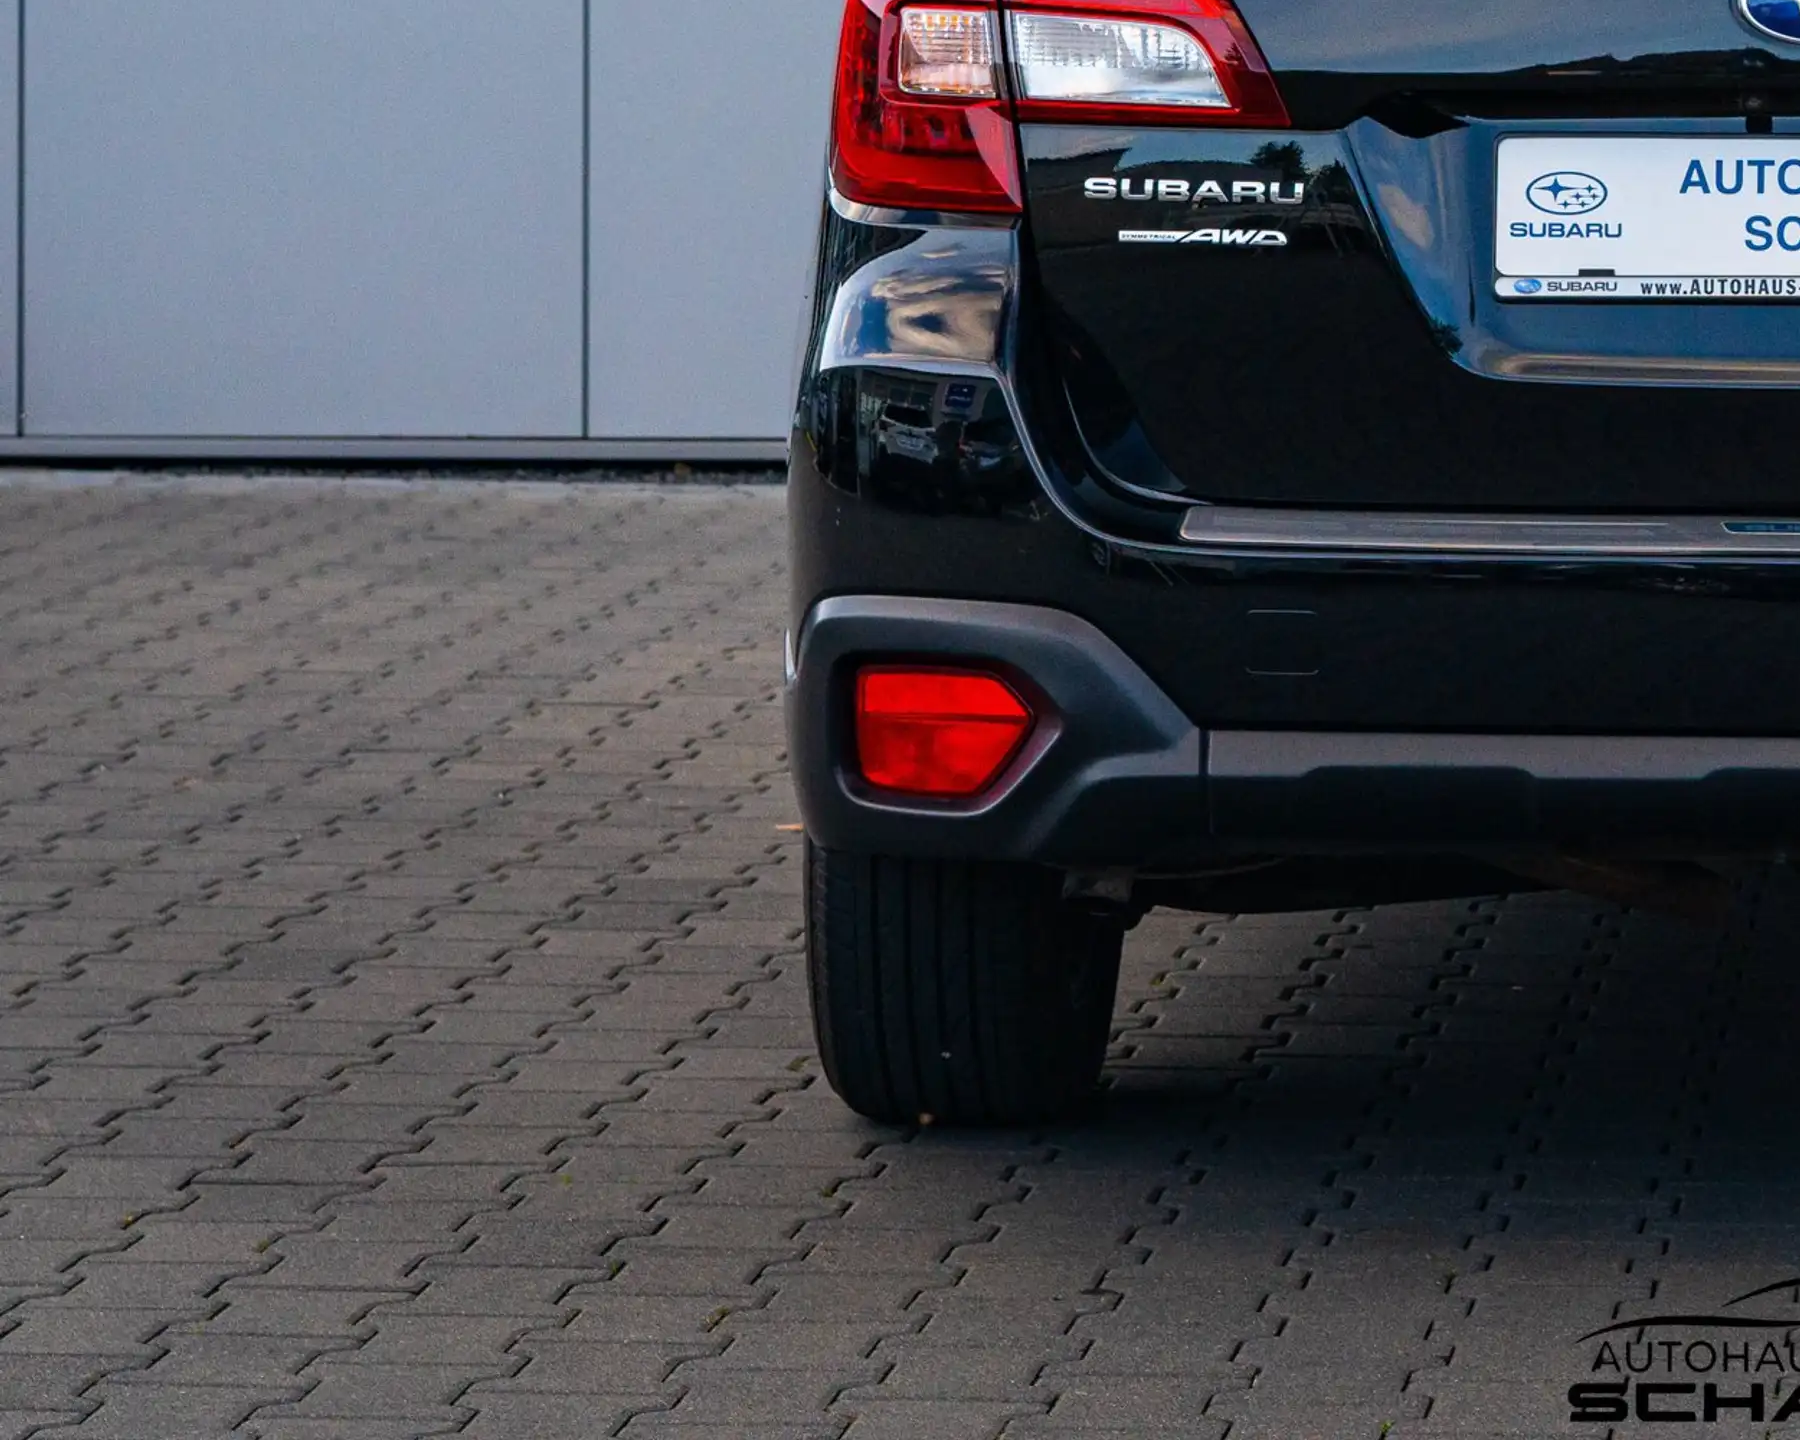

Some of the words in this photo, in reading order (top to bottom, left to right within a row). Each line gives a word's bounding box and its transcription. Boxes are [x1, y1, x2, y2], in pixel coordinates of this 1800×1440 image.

[1084, 177, 1305, 205] SUBARU
[1179, 228, 1288, 246] AWD
[1509, 221, 1623, 239] SUBARU
[1546, 280, 1618, 293] SUBARU
